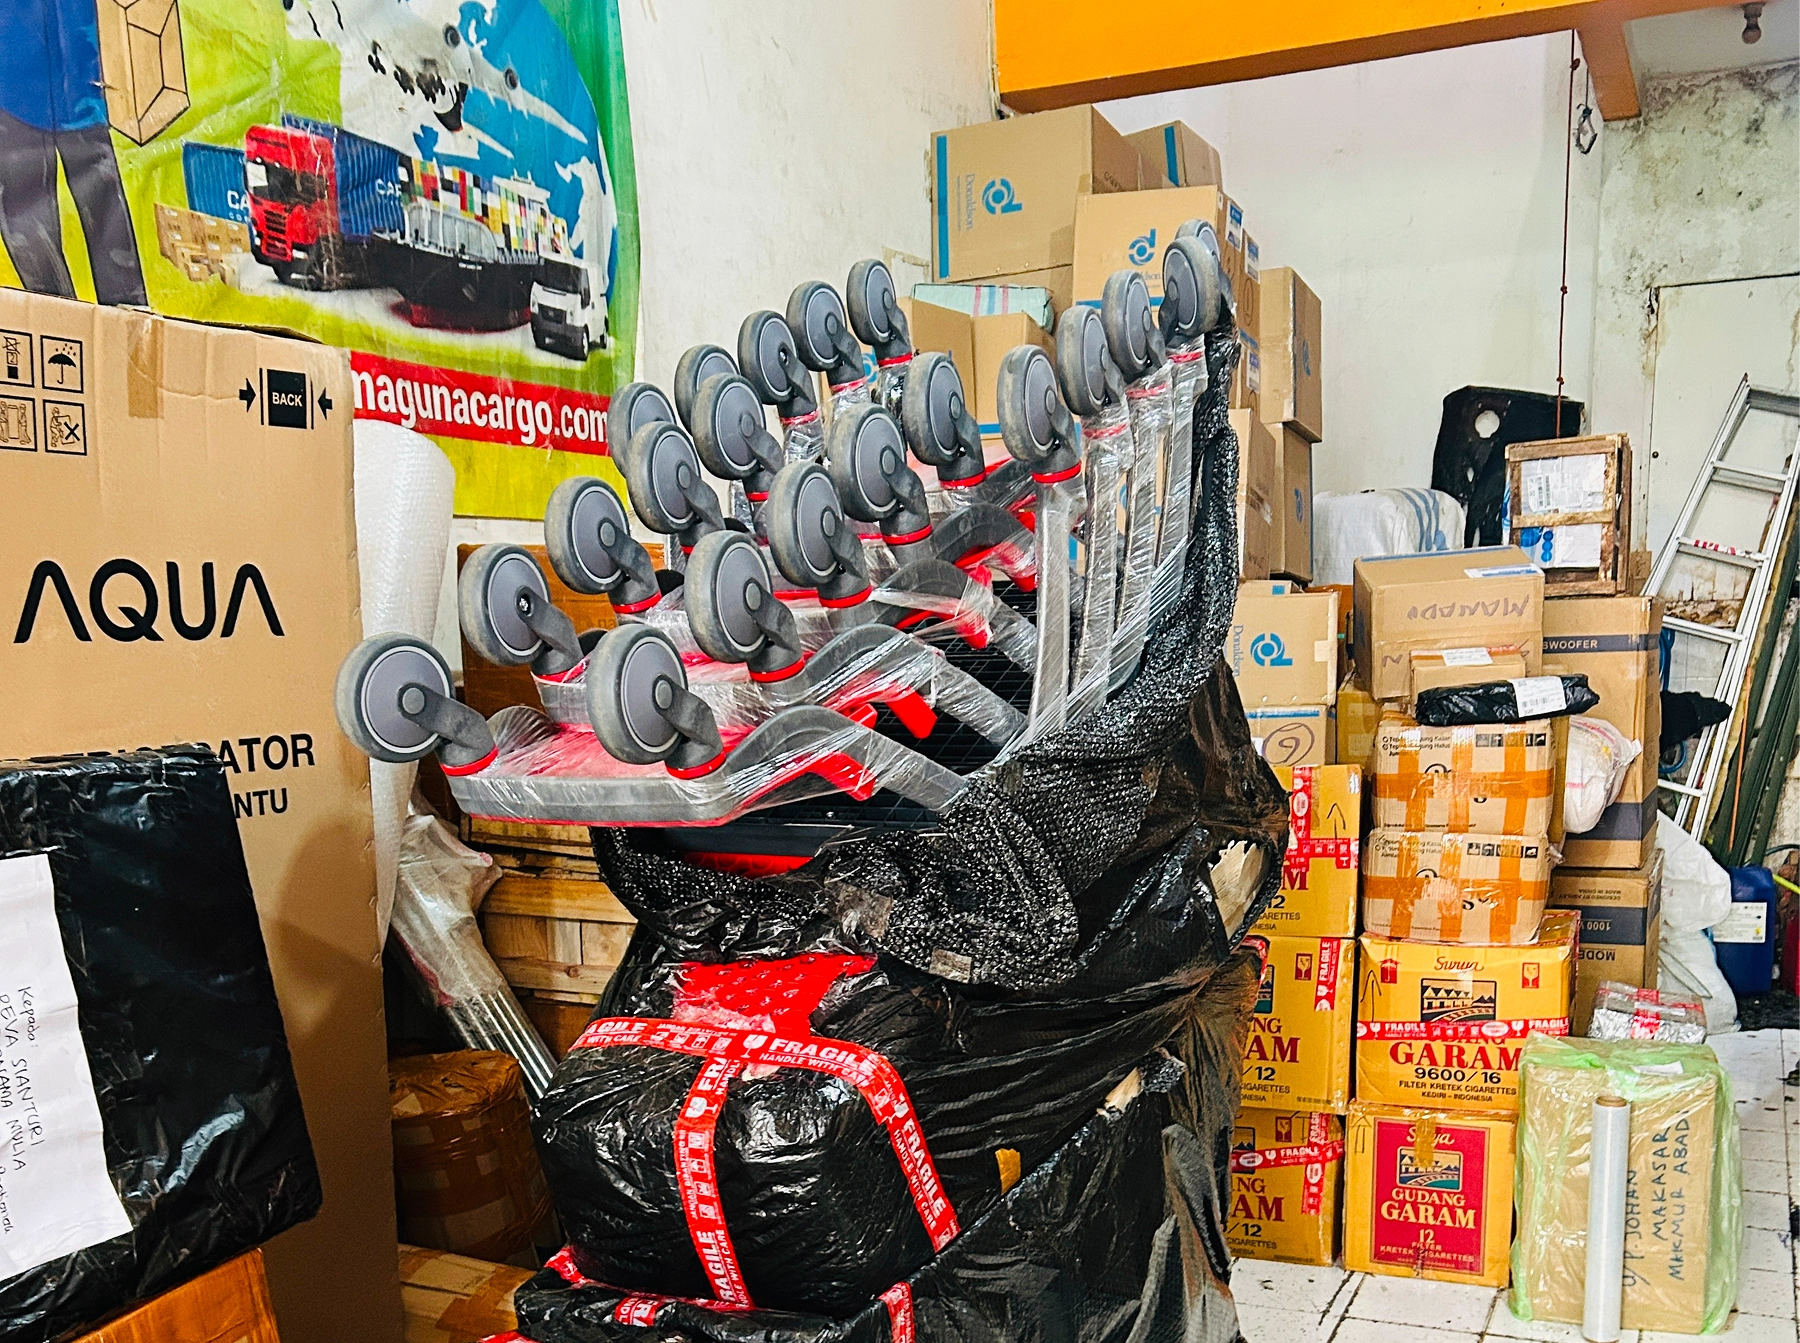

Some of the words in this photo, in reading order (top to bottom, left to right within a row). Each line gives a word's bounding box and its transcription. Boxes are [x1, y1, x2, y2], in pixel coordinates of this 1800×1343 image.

[271, 391, 303, 408] BACK
[13, 558, 285, 644] AQUA
[1407, 594, 1530, 620] MANADO
[1543, 639, 1598, 650] BWOOFER
[217, 732, 316, 775] ATOR
[235, 788, 288, 818] NTU
[1587, 921, 1611, 931] 1000
[1319, 941, 1331, 981] FRAGILE
[1434, 956, 1485, 974] Surya
[1577, 949, 1616, 961] MODE
[586, 1021, 648, 1036] AGILE
[1384, 1022, 1426, 1032] FRAGILE
[614, 1034, 642, 1043] CARE
[769, 1037, 878, 1073] FRAGILE
[1245, 1035, 1301, 1063] AM
[1389, 1041, 1523, 1071] GARAM
[759, 1051, 805, 1065] HANDLE
[807, 1056, 840, 1071] WITH
[1242, 1066, 1276, 1082] /12
[1414, 1067, 1501, 1085] 9600/16
[1399, 1080, 1427, 1089] FILTER
[1430, 1082, 1462, 1091] KRETEK
[1465, 1085, 1517, 1096] CIGARETTES
[1421, 1091, 1446, 1099] KEDIRI
[1453, 1093, 1493, 1102] INDONESIA
[11, 1058, 45, 1146] SIANTURI
[6, 1119, 26, 1171] MULIA
[1406, 1126, 1455, 1146] Sya
[903, 1118, 947, 1218] FRAGILE
[894, 1129, 915, 1173] HANDLE
[910, 1173, 924, 1201] WITH
[921, 1201, 937, 1230] CARE
[1651, 1126, 1671, 1242] MAKASAR
[1391, 1187, 1466, 1206] GUDANG
[1381, 1201, 1476, 1229] GARAM
[1226, 1222, 1262, 1238] /12
[1419, 1228, 1435, 1244] 12
[715, 1229, 731, 1255] CARE
[1380, 1245, 1414, 1255] KRETEK
[1411, 1241, 1442, 1250] FILTER
[696, 1231, 736, 1301] RAGILE
[724, 1257, 739, 1281] WITH
